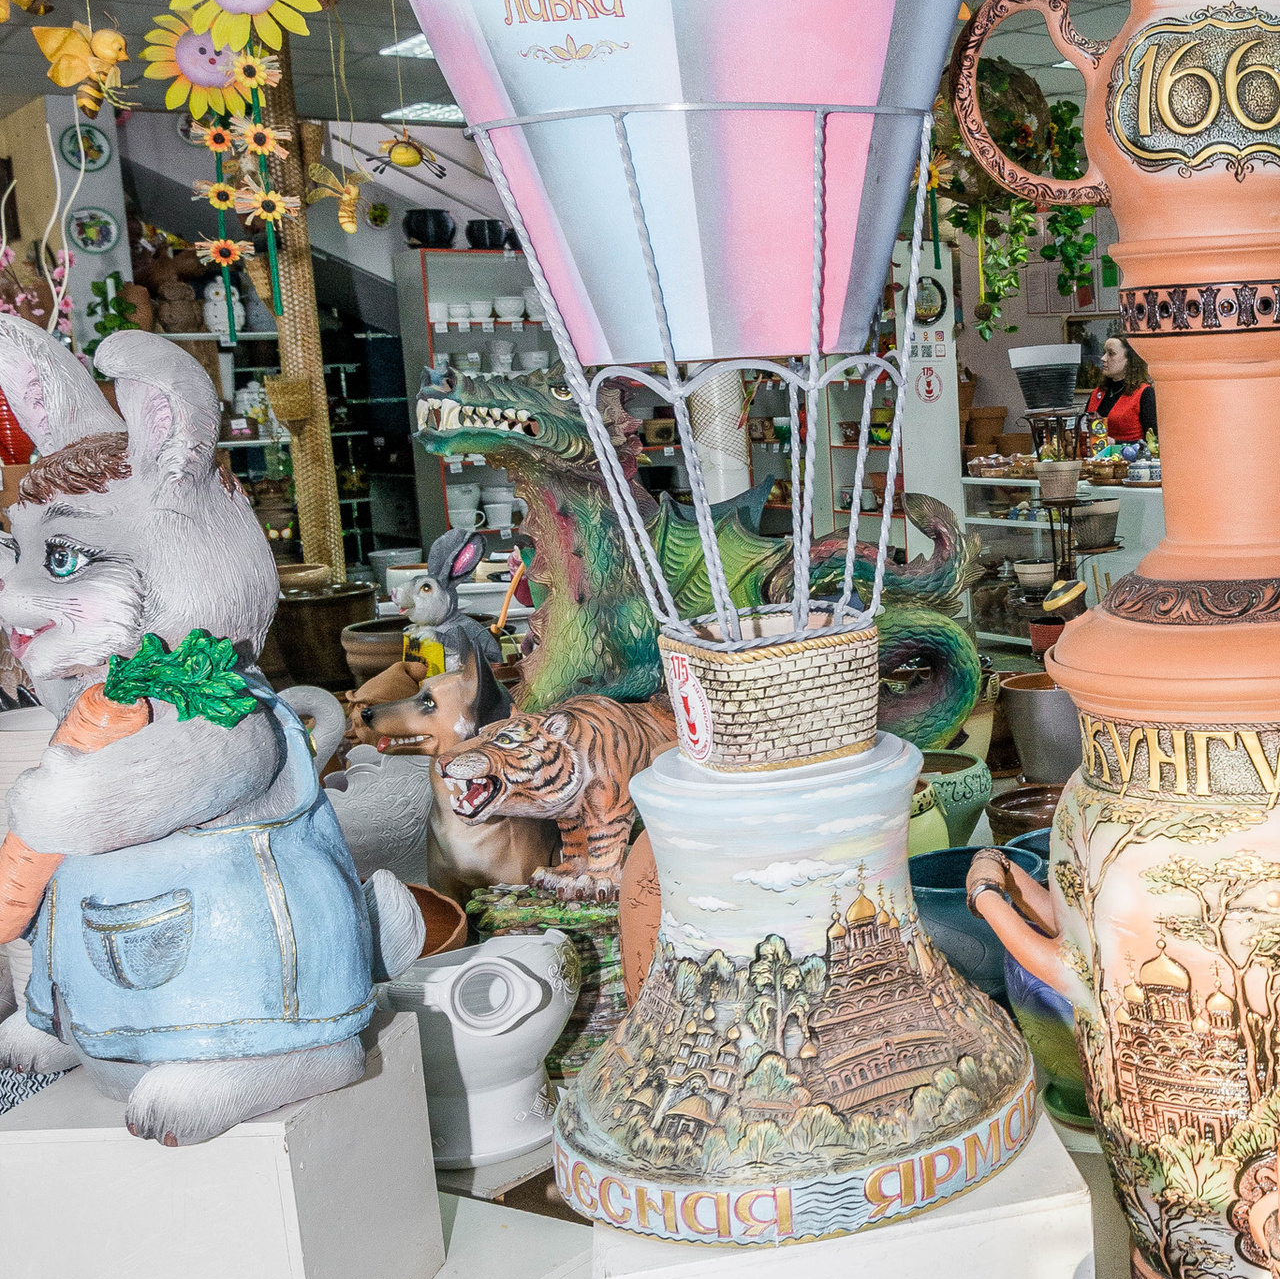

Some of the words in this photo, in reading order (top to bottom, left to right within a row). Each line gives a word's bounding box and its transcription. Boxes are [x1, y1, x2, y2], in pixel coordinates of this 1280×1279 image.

[671, 655, 689, 682] 175
[554, 1140, 794, 1239] БЕСНАЯ
[863, 1080, 1037, 1219] ЯРМАР
